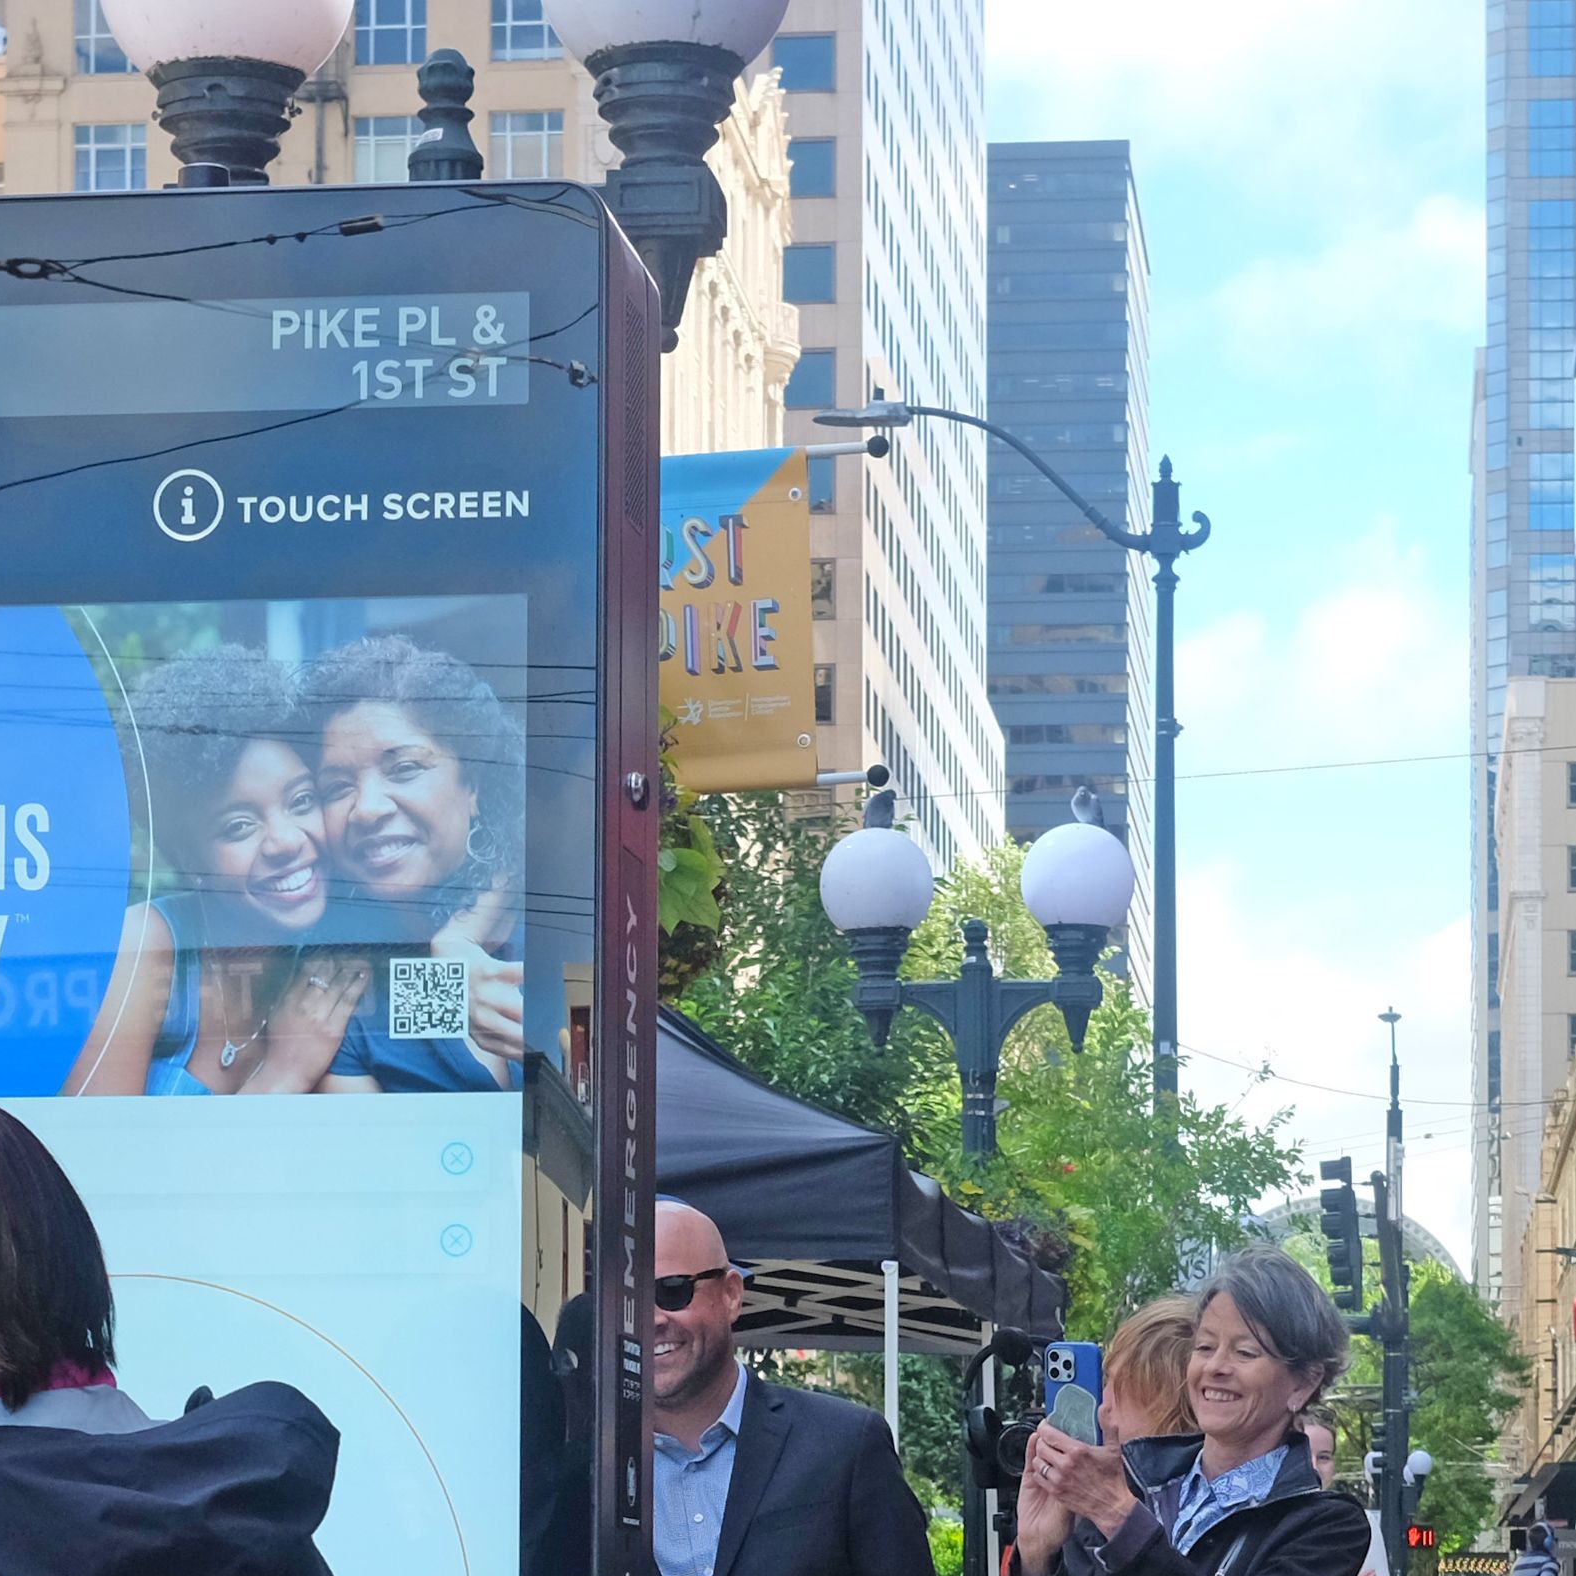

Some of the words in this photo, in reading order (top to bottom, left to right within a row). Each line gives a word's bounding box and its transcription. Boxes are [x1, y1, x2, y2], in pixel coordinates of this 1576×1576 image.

[272, 307, 381, 349] PIKE
[397, 305, 457, 346] PL
[472, 304, 507, 345] &
[351, 358, 434, 400] 1ST
[447, 356, 508, 398] ST
[236, 494, 368, 524] TOUCH
[382, 490, 530, 521] SCREEN
[622, 893, 639, 1337] EMERGENCY
